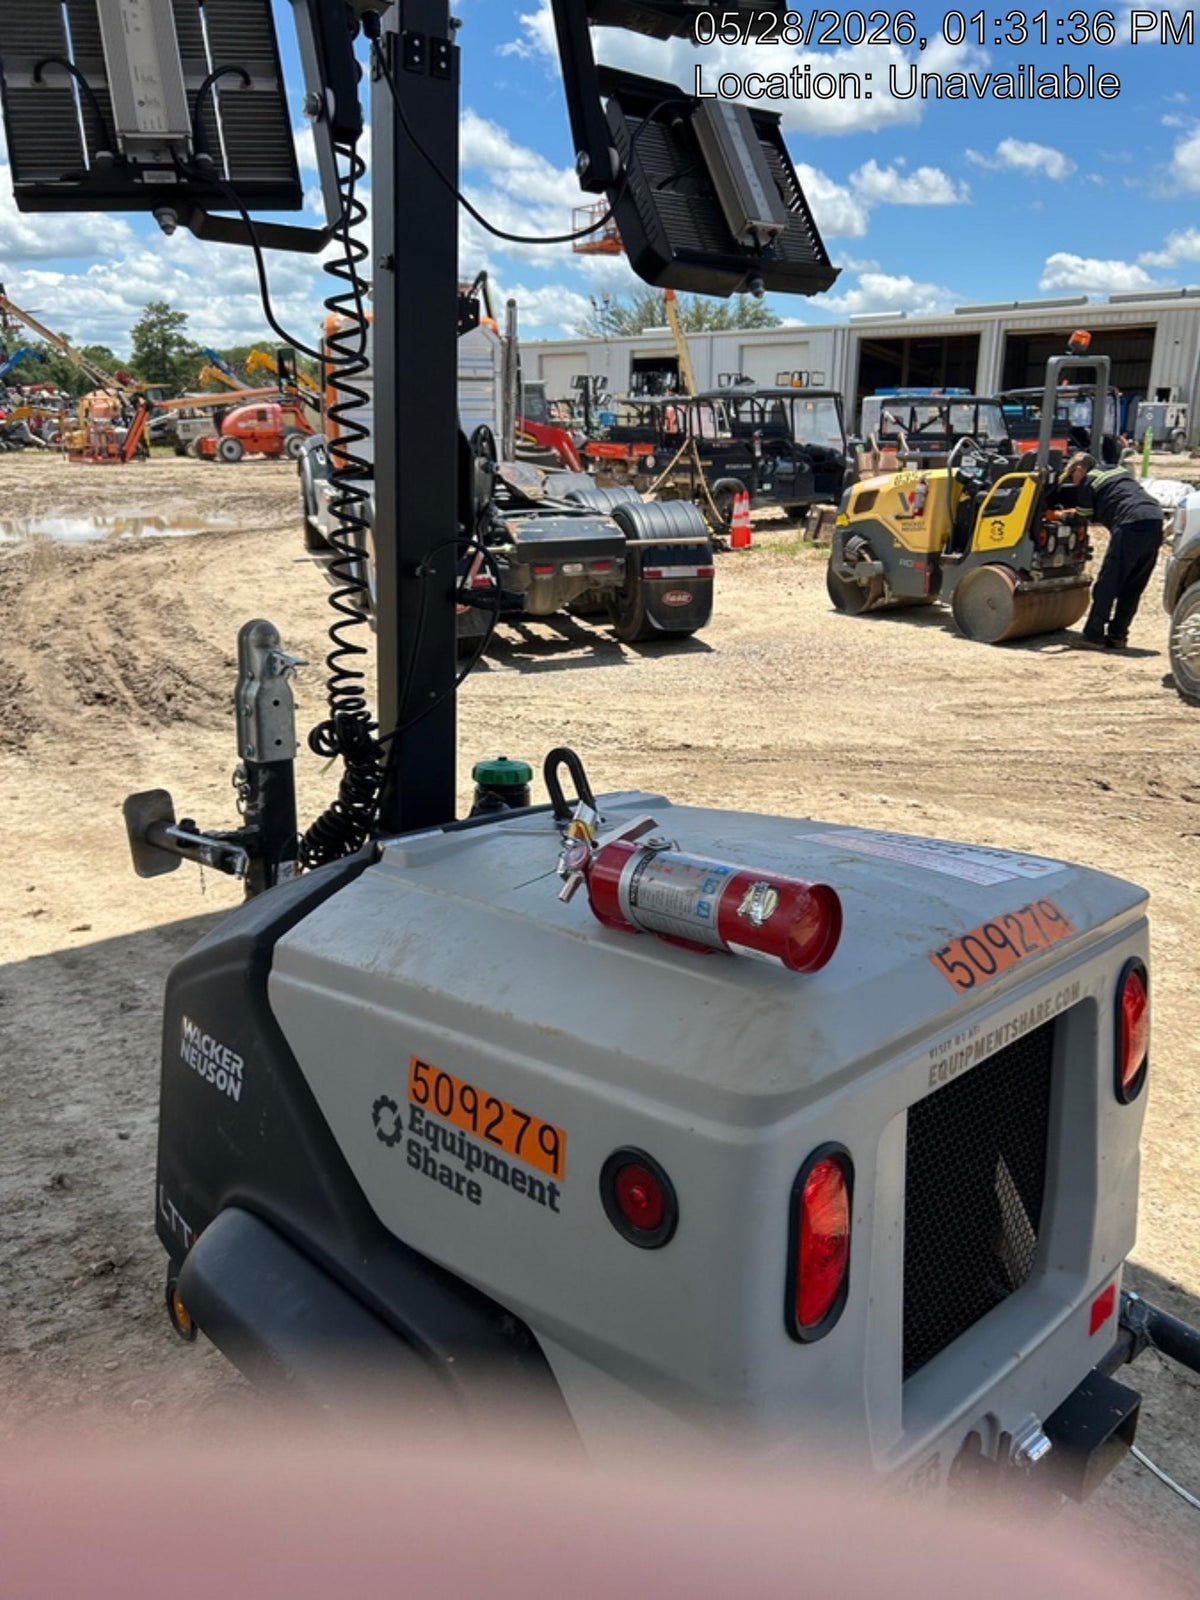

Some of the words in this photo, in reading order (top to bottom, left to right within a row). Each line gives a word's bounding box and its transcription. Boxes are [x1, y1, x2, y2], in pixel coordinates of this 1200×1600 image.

[936, 898, 1069, 990] 509279
[180, 1039, 243, 1102] NEUSON
[181, 1015, 244, 1080] WACKER
[927, 980, 1080, 1087] EQUIPMENTSHARE.COM
[407, 1103, 561, 1214] Equipment
[411, 1059, 560, 1174] 509279
[406, 1138, 482, 1206] Share
